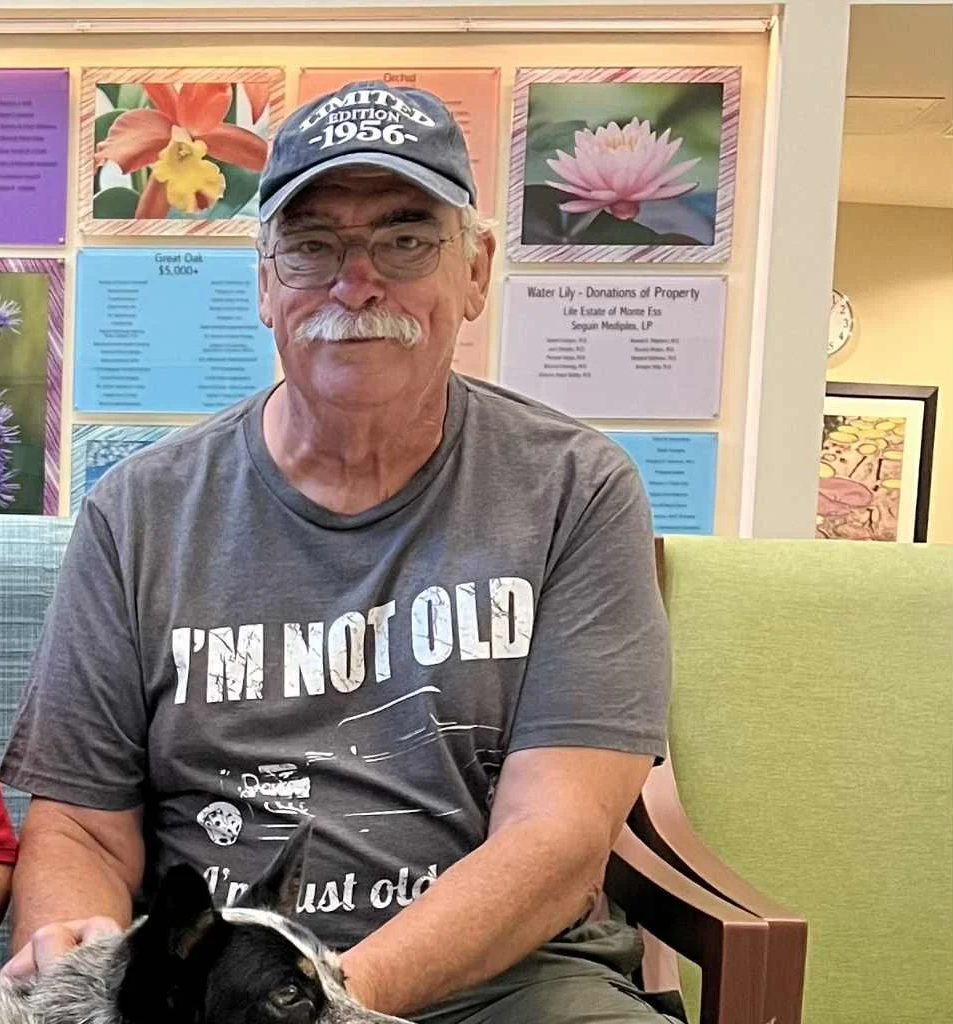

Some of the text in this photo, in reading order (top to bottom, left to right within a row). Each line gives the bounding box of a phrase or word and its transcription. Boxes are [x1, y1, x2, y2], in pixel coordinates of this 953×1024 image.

[299, 89, 436, 133] LIMITED
[328, 108, 400, 125] EDITION
[154, 252, 203, 263] Great Oak
[158, 265, 198, 276] $5,000+
[527, 286, 555, 298] Water
[558, 286, 575, 301] Lily
[585, 286, 637, 298] Donations
[640, 286, 651, 298] of
[654, 286, 700, 301] Property
[580, 306, 606, 316] Estate
[607, 306, 617, 316] of
[571, 320, 598, 332] Seguin
[172, 577, 535, 704] I'M NOT OLD
[296, 872, 358, 913] ust
